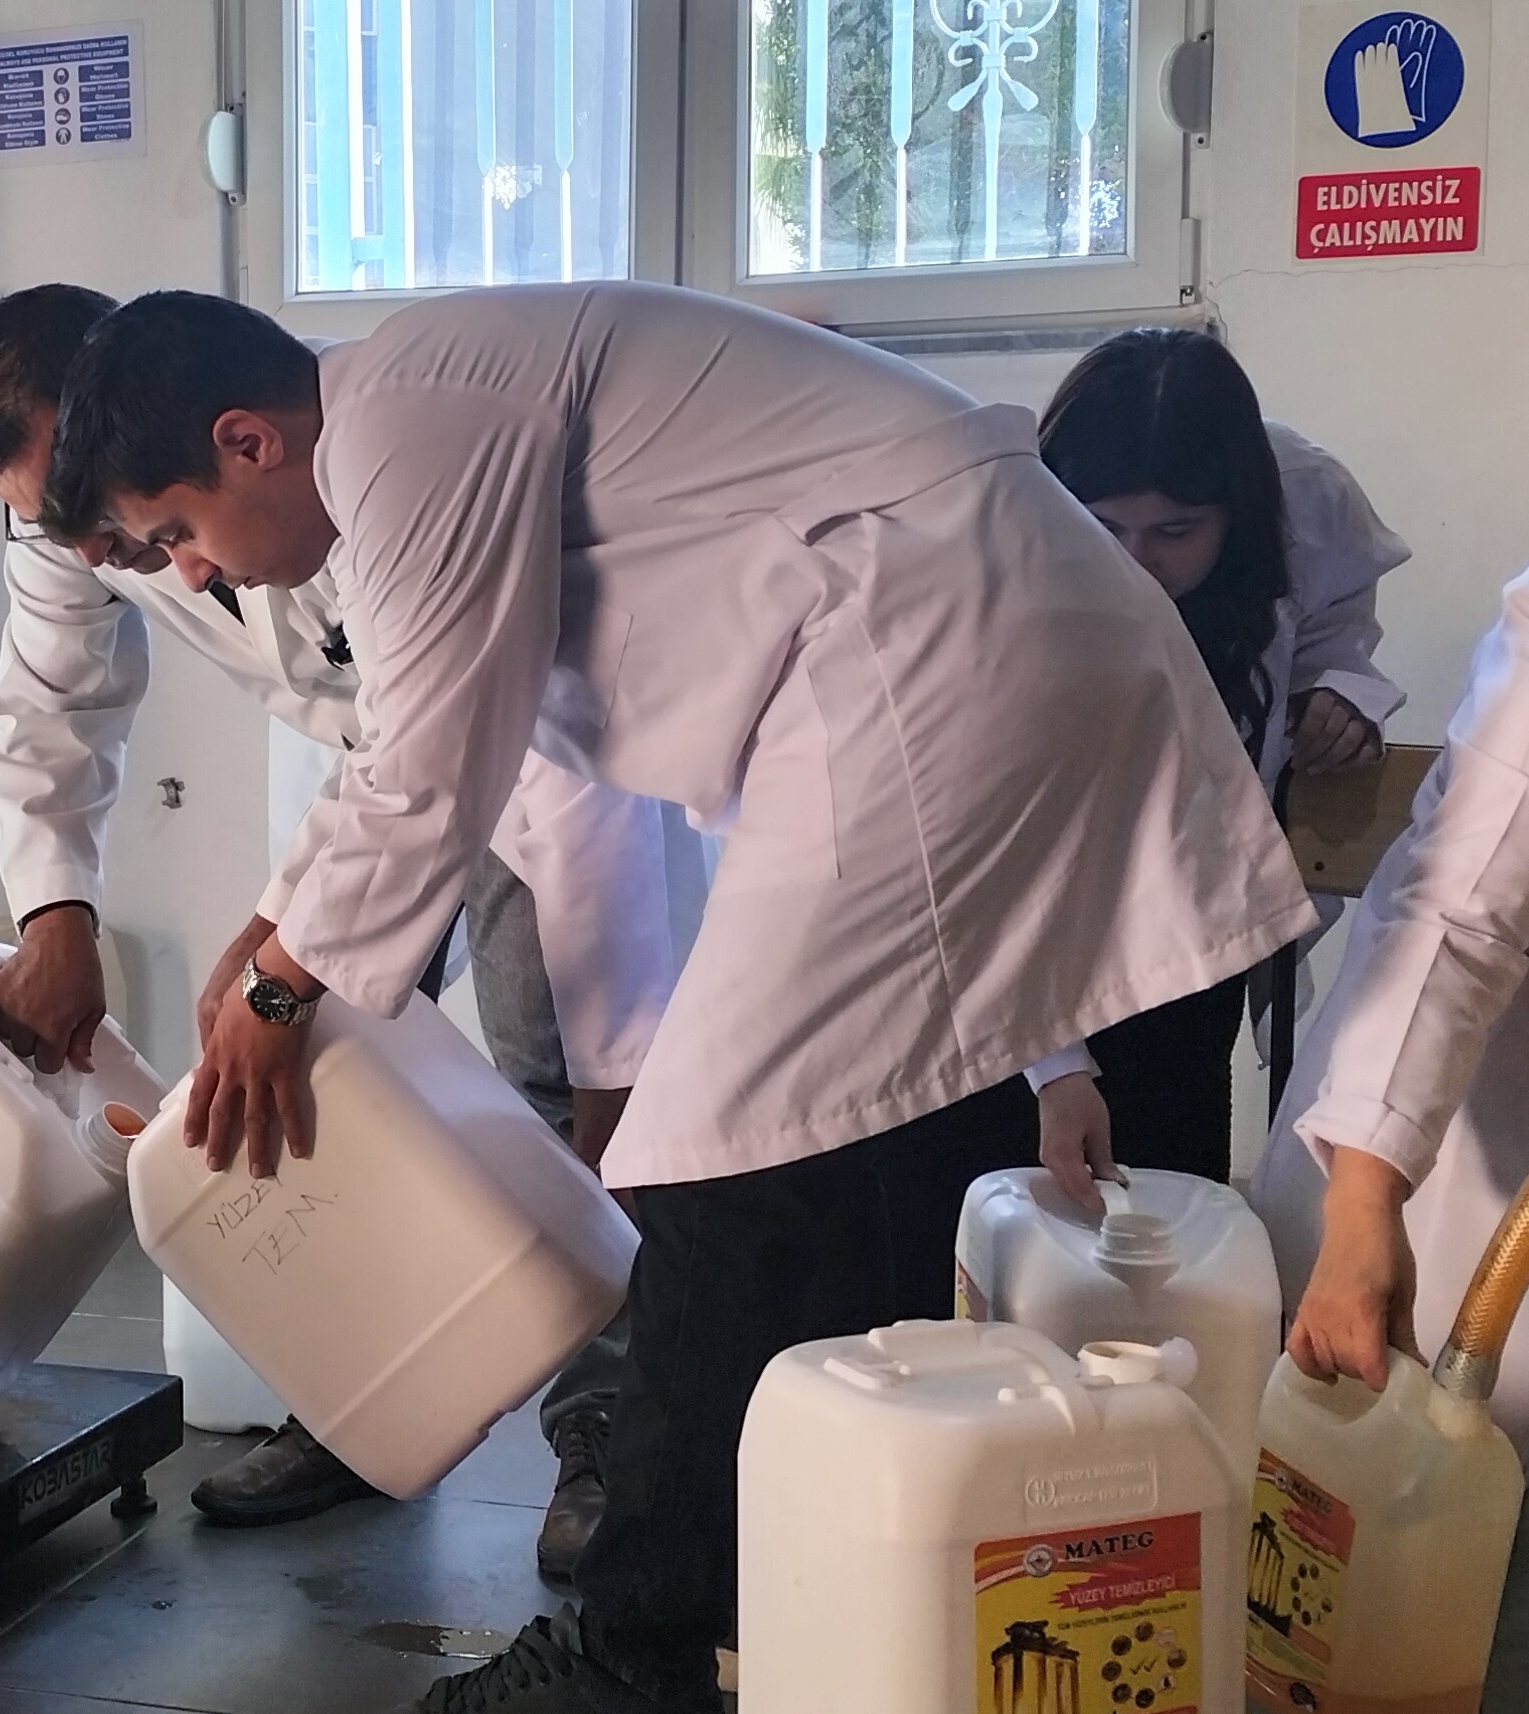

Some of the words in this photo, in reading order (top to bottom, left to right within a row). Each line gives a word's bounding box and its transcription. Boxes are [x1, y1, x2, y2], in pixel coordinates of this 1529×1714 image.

[1316, 174, 1461, 211] ELDİVENSİZ
[1310, 217, 1464, 254] ÇALIŞMAYIN
[20, 1441, 111, 1510] KOBASTAR
[1064, 1531, 1154, 1560] MATEG
[1069, 1587, 1106, 1605] YÜZEY
[1108, 1573, 1177, 1599] TEMİZLEYİCİ
